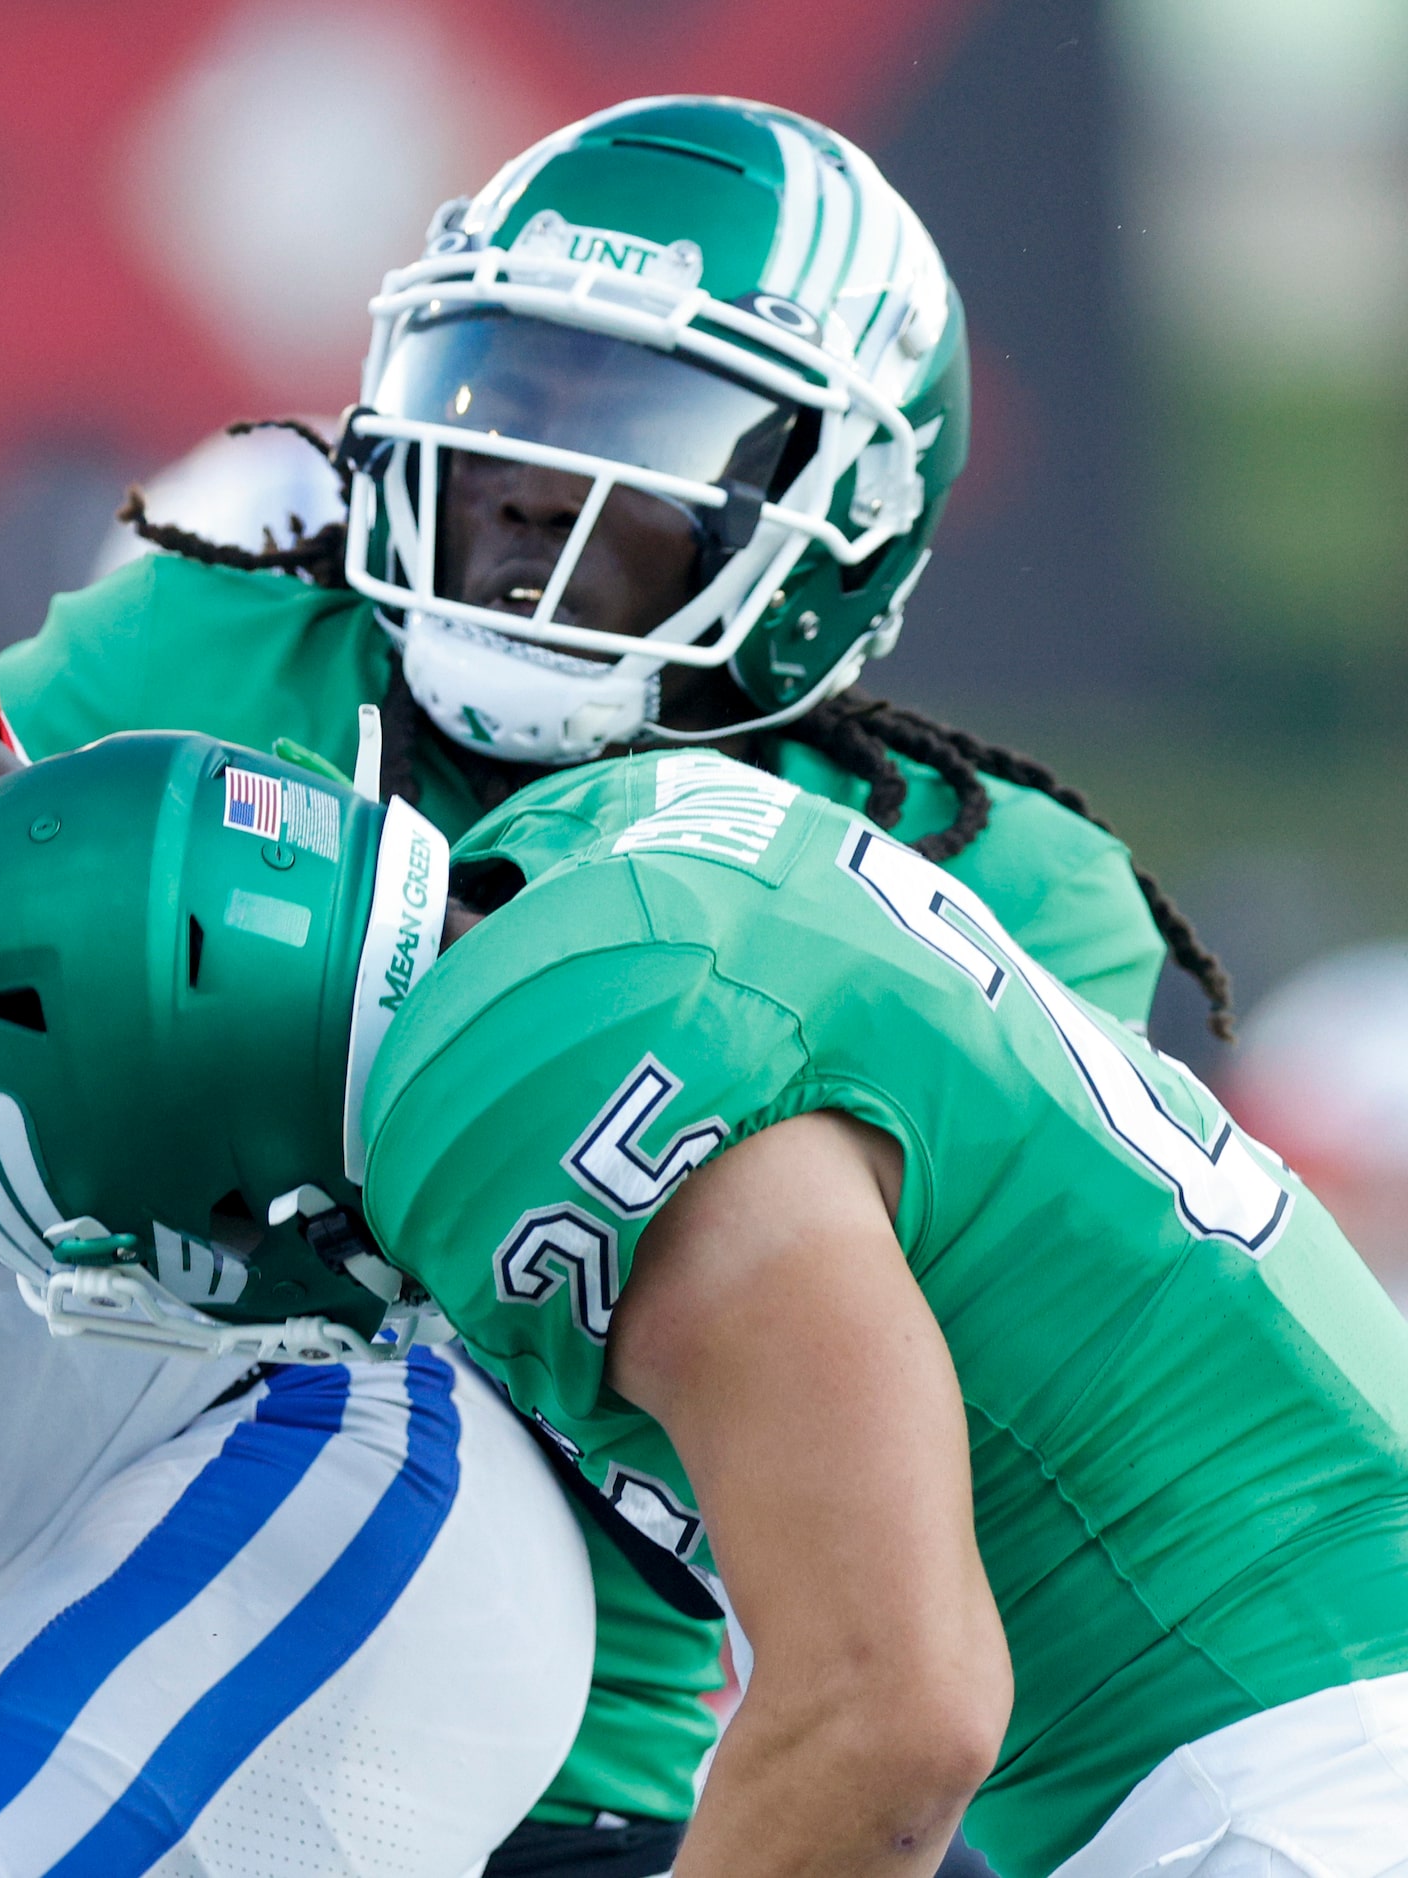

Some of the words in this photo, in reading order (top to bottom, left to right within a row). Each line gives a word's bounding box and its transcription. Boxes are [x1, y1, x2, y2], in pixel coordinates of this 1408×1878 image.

[569, 235, 658, 276] UNT
[379, 910, 423, 1013] MEAN
[401, 829, 432, 910] GREEN
[492, 1050, 731, 1347] 25
